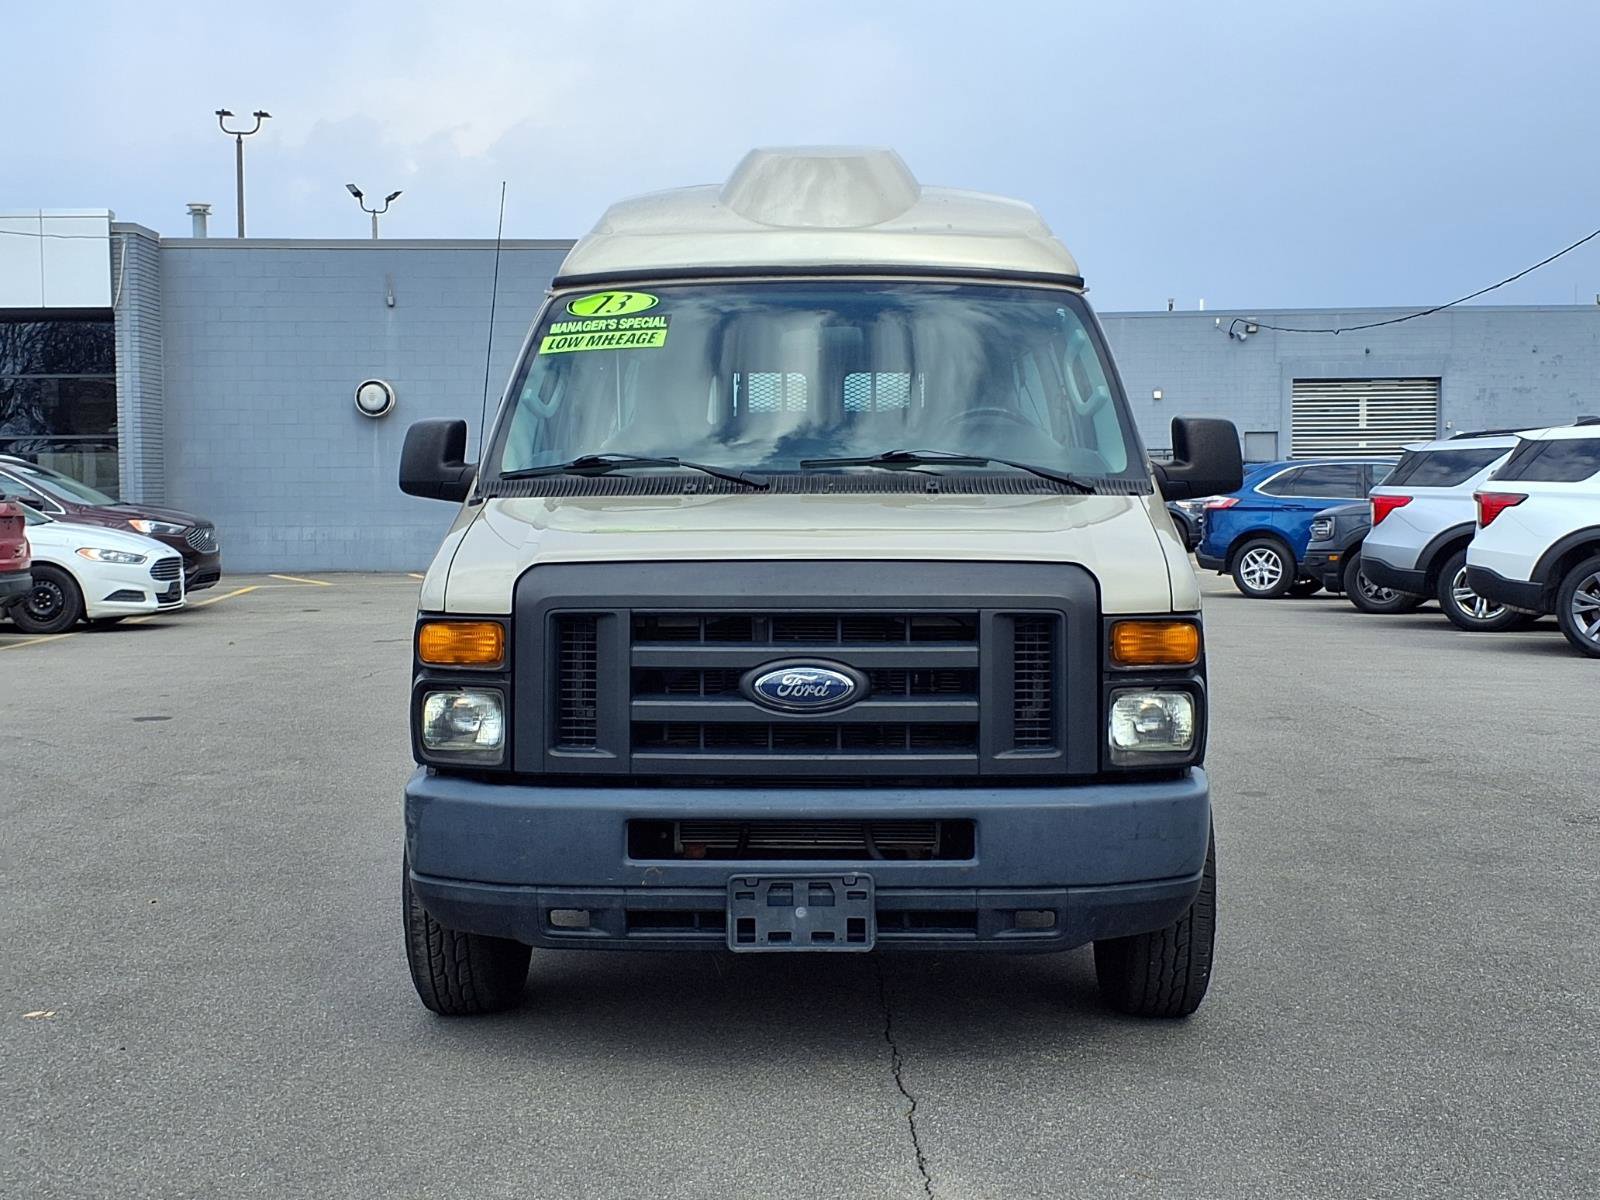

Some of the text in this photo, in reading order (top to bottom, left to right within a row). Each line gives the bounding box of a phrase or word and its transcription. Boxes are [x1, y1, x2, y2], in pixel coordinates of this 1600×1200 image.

[550, 316, 667, 334] MANAGER'S SPECIAL
[547, 331, 658, 350] LOW MILEAGE
[776, 674, 831, 696] Ford
